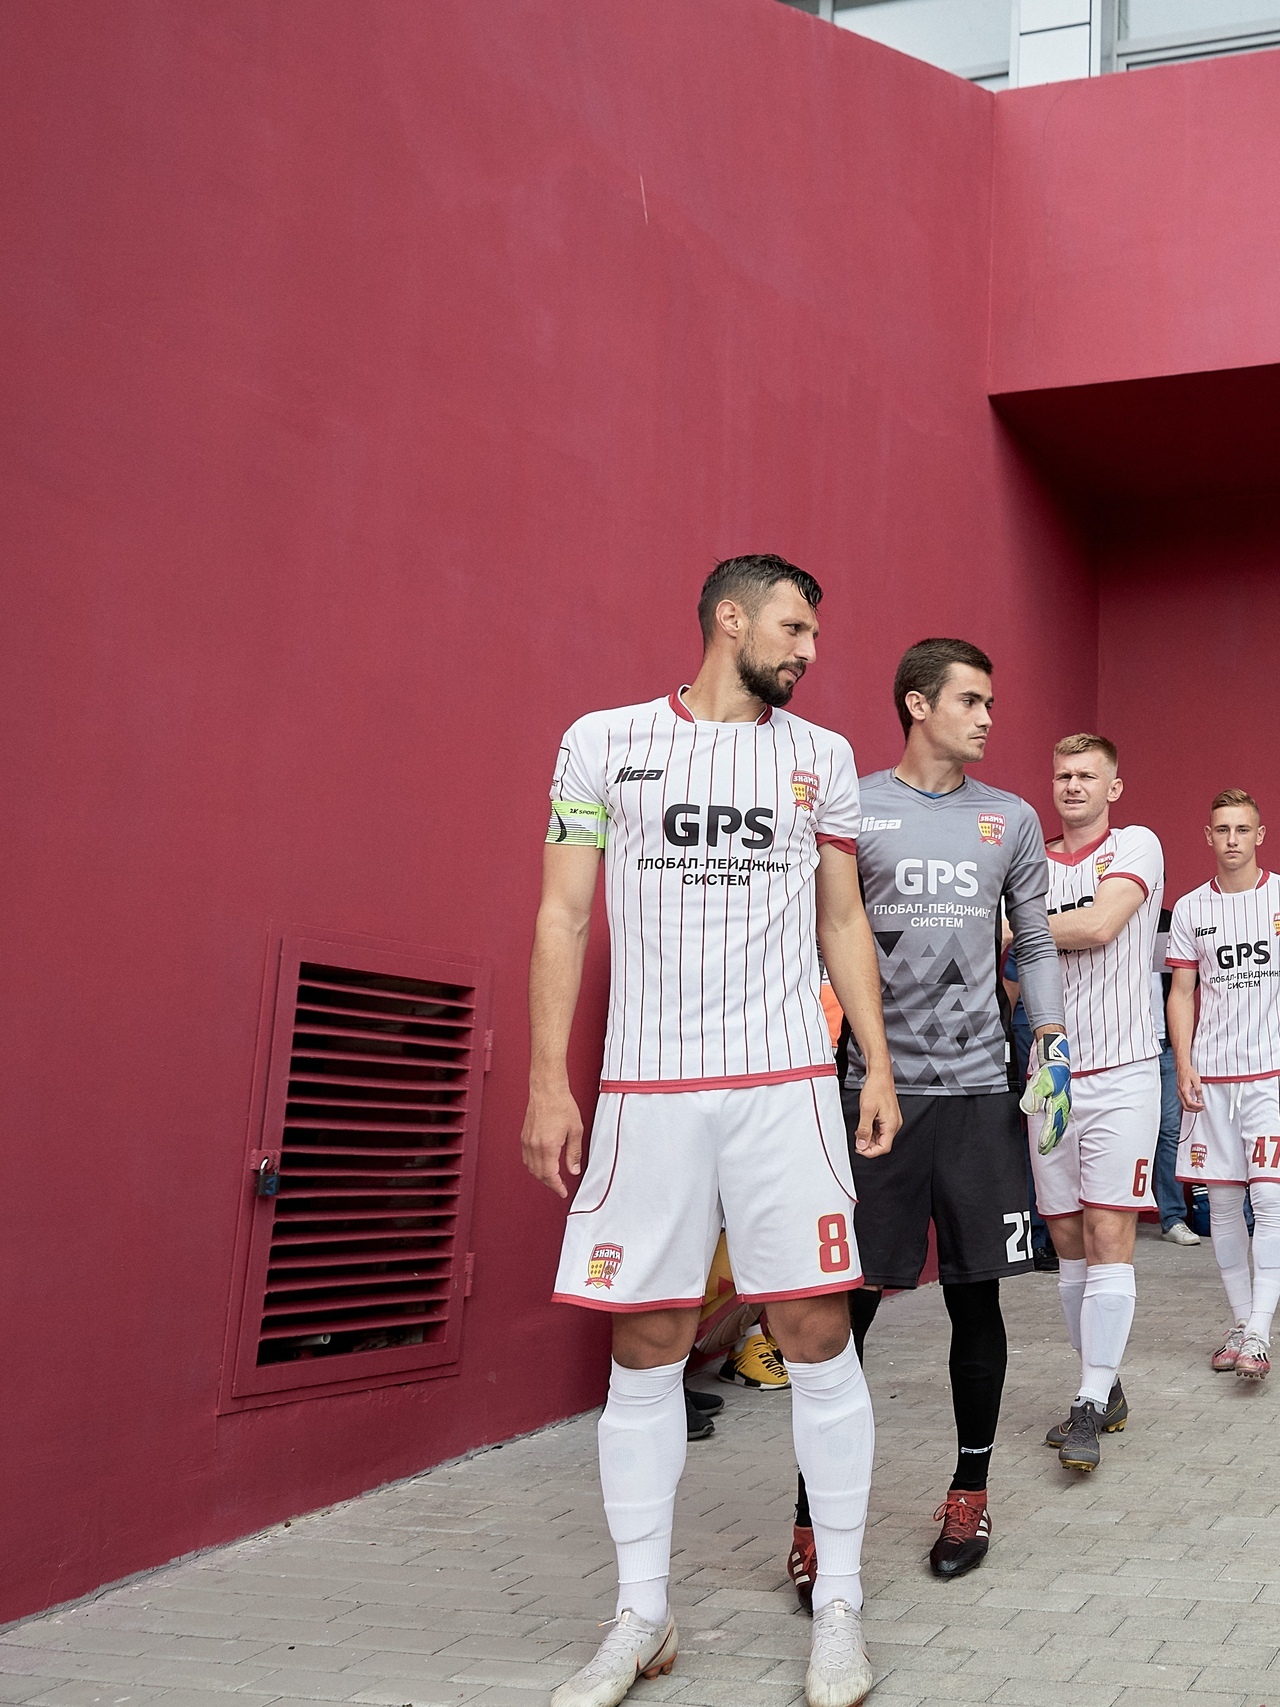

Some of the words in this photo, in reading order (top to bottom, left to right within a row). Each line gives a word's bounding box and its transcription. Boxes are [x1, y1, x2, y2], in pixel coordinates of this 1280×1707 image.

[664, 803, 774, 849] GPS
[637, 857, 791, 873] ГЛОБАЛ-ПЕЙДЖИНГ
[682, 874, 750, 886] СИСТЕМ
[895, 858, 979, 898] GPS
[873, 902, 991, 918] ГЛОБАЛ-ПЕЙДЖИНГ
[910, 917, 963, 928] СИСТЕМ
[1216, 940, 1271, 969] GPS
[1228, 980, 1260, 990] СИСТЕМ
[1132, 1158, 1149, 1198] 6
[817, 1212, 851, 1273] 8
